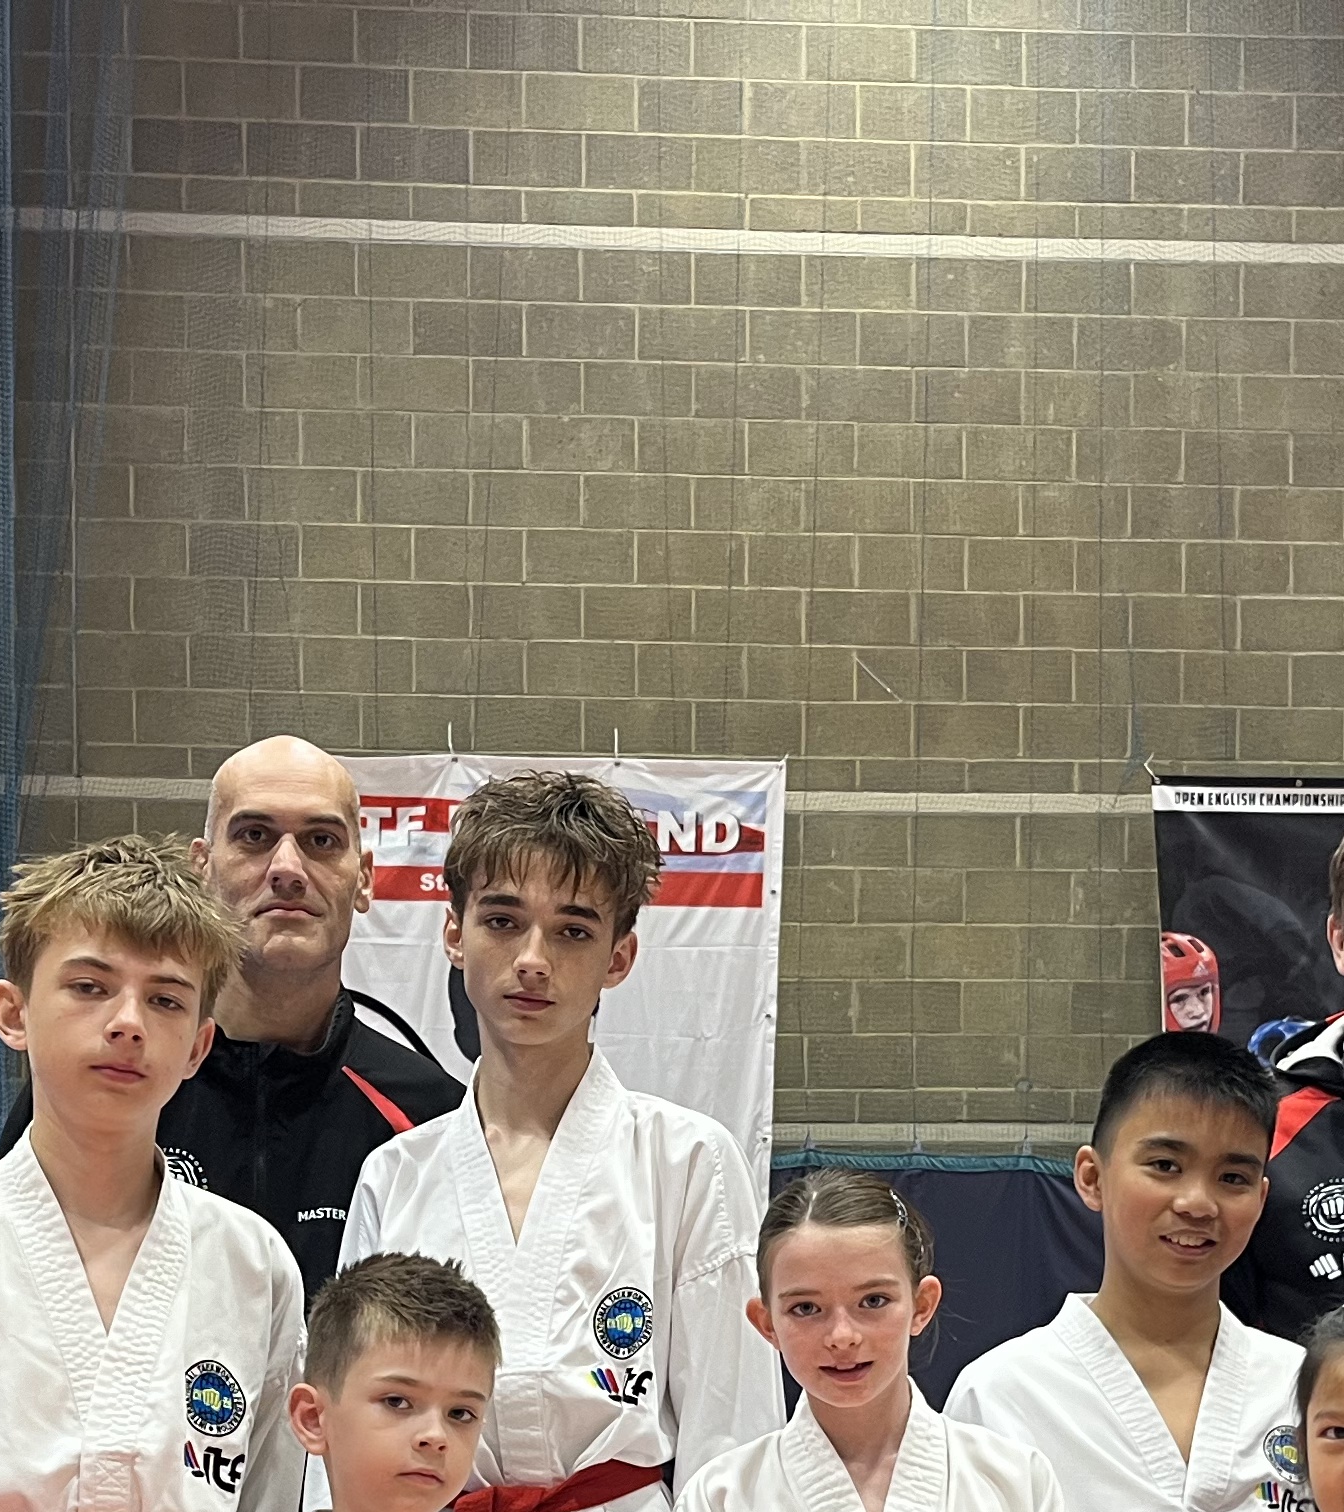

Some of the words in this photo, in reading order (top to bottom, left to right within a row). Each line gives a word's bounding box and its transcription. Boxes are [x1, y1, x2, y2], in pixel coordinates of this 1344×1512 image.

[1174, 792, 1204, 805] OPEN
[1207, 792, 1256, 806] ENGLISH
[298, 1207, 347, 1223] MASTER
